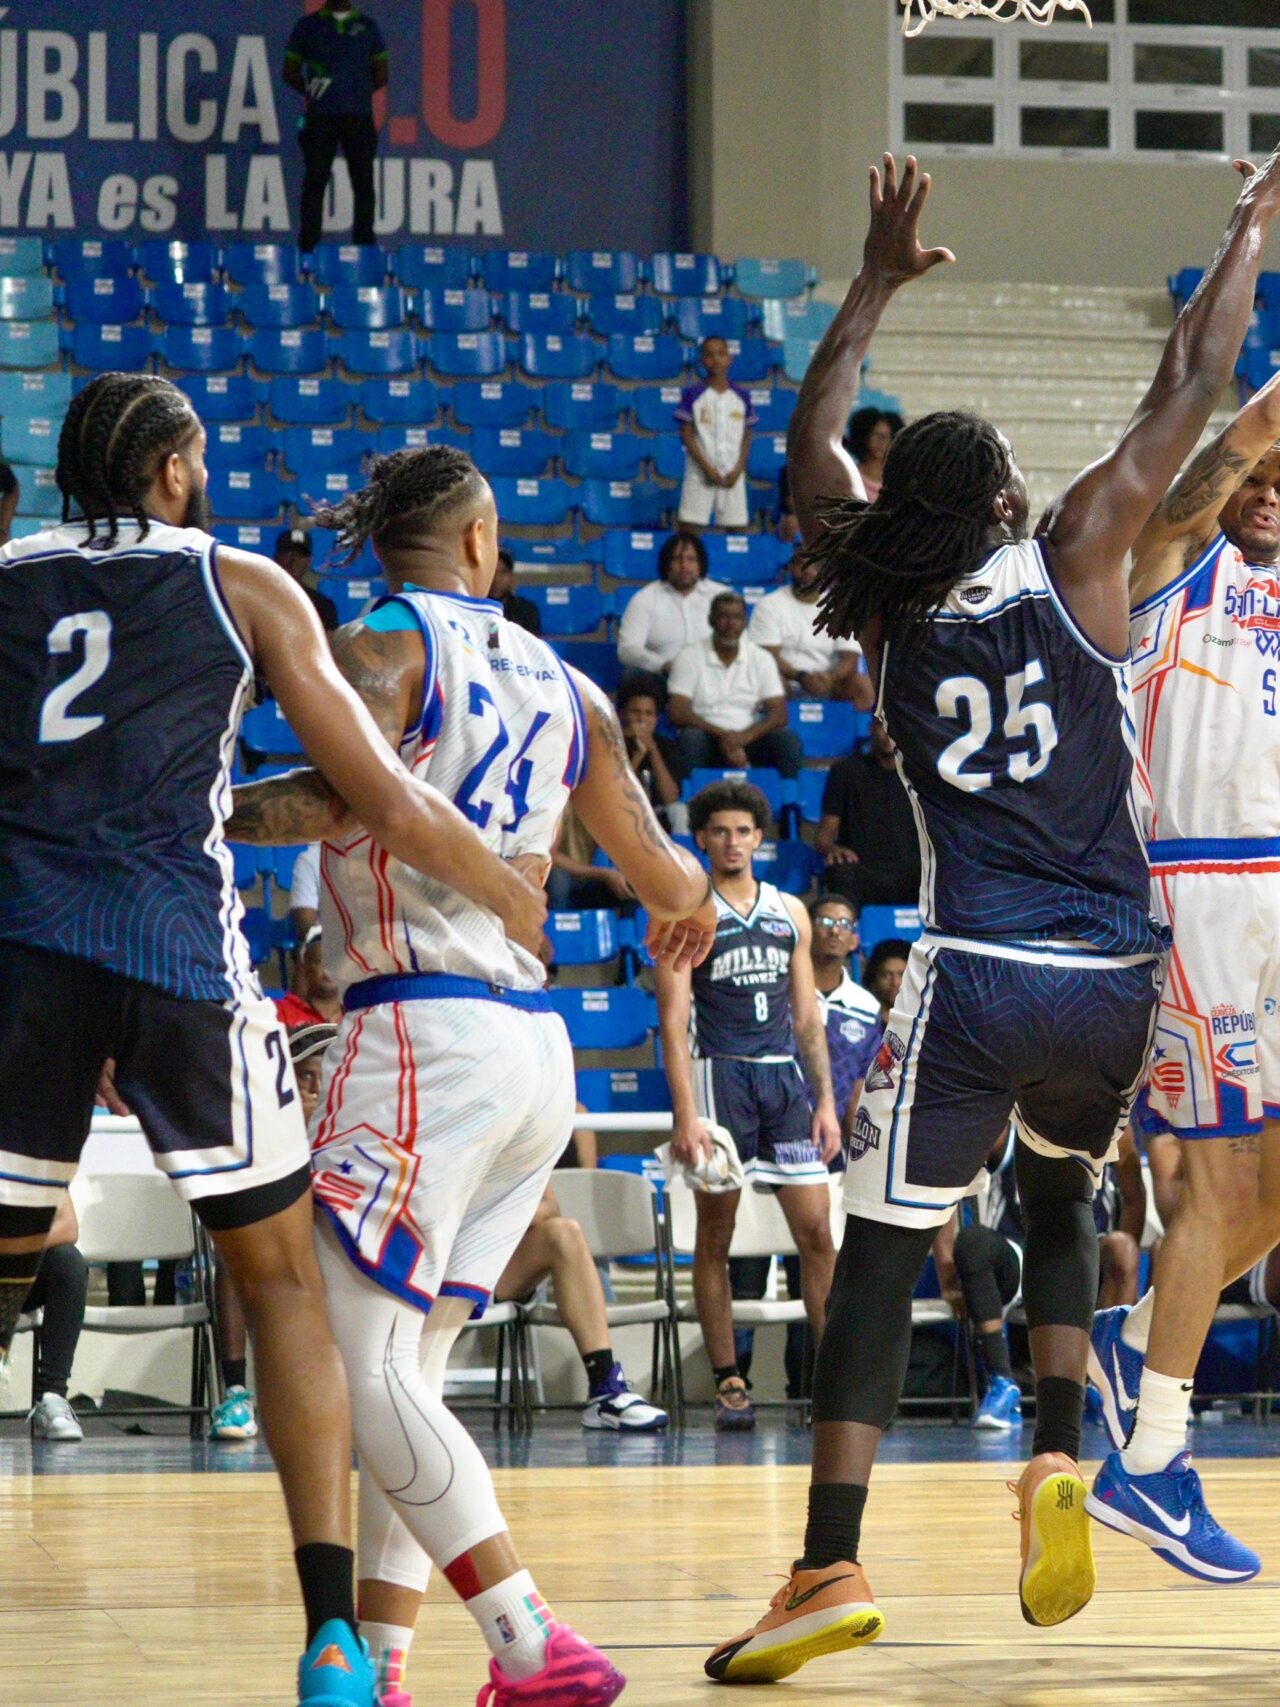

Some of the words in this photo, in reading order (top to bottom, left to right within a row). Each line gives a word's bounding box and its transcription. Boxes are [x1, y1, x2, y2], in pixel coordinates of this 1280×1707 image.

[0, 152, 76, 229] YA
[97, 173, 179, 232] es
[205, 154, 291, 232] LA
[38, 609, 114, 744] 2
[933, 658, 1059, 795] 25
[754, 991, 769, 1023] 8
[1211, 1010, 1256, 1036] REPÚB
[264, 1028, 296, 1110] 2
